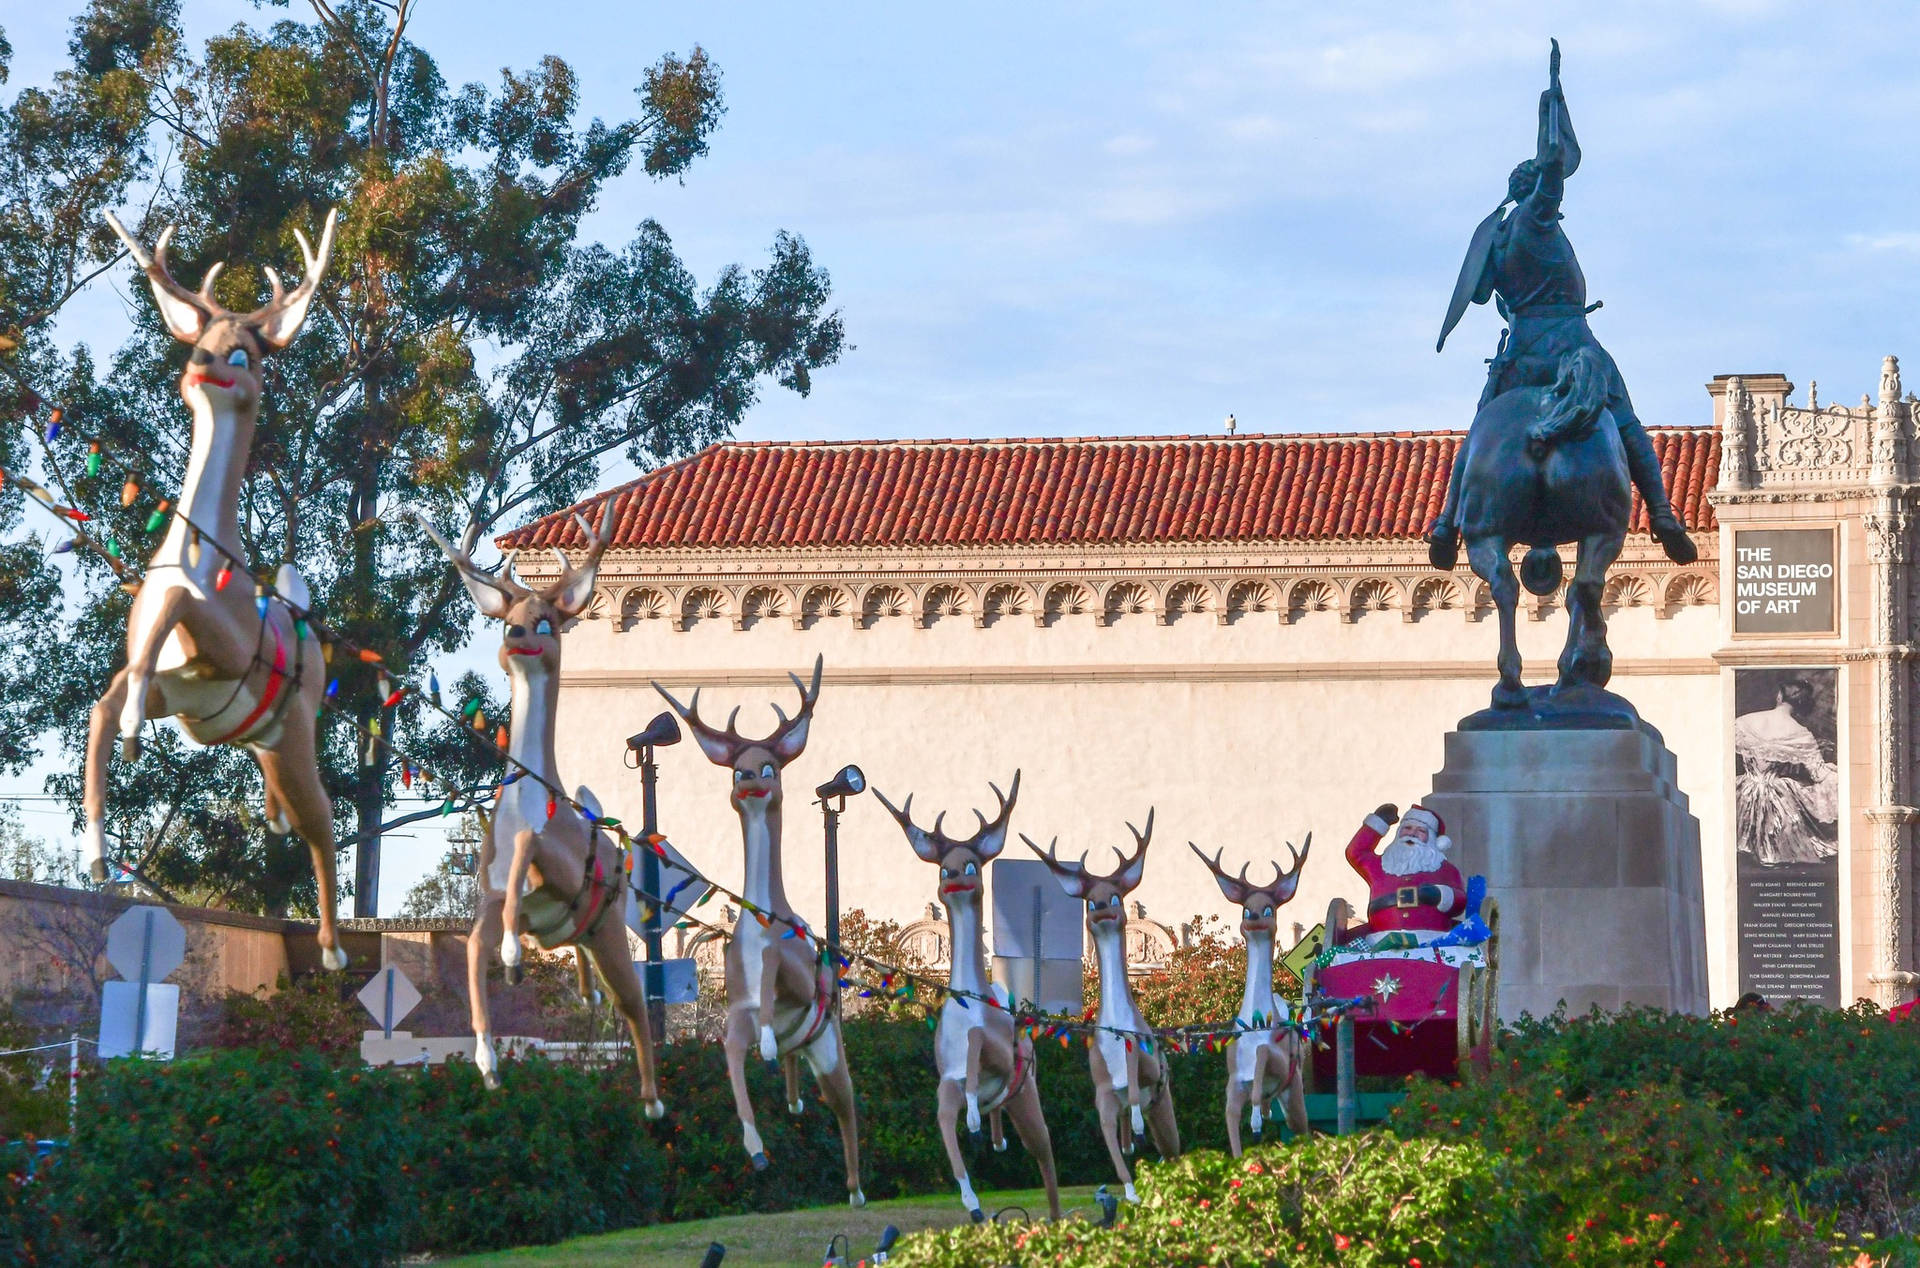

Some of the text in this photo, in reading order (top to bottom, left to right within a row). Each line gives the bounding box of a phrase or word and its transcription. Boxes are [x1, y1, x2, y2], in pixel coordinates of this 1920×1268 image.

[1736, 548, 1771, 561] THE
[1736, 564, 1833, 579] SAN DIEGO
[1737, 582, 1816, 596] MUSEUM
[1736, 600, 1800, 614] OF ART
